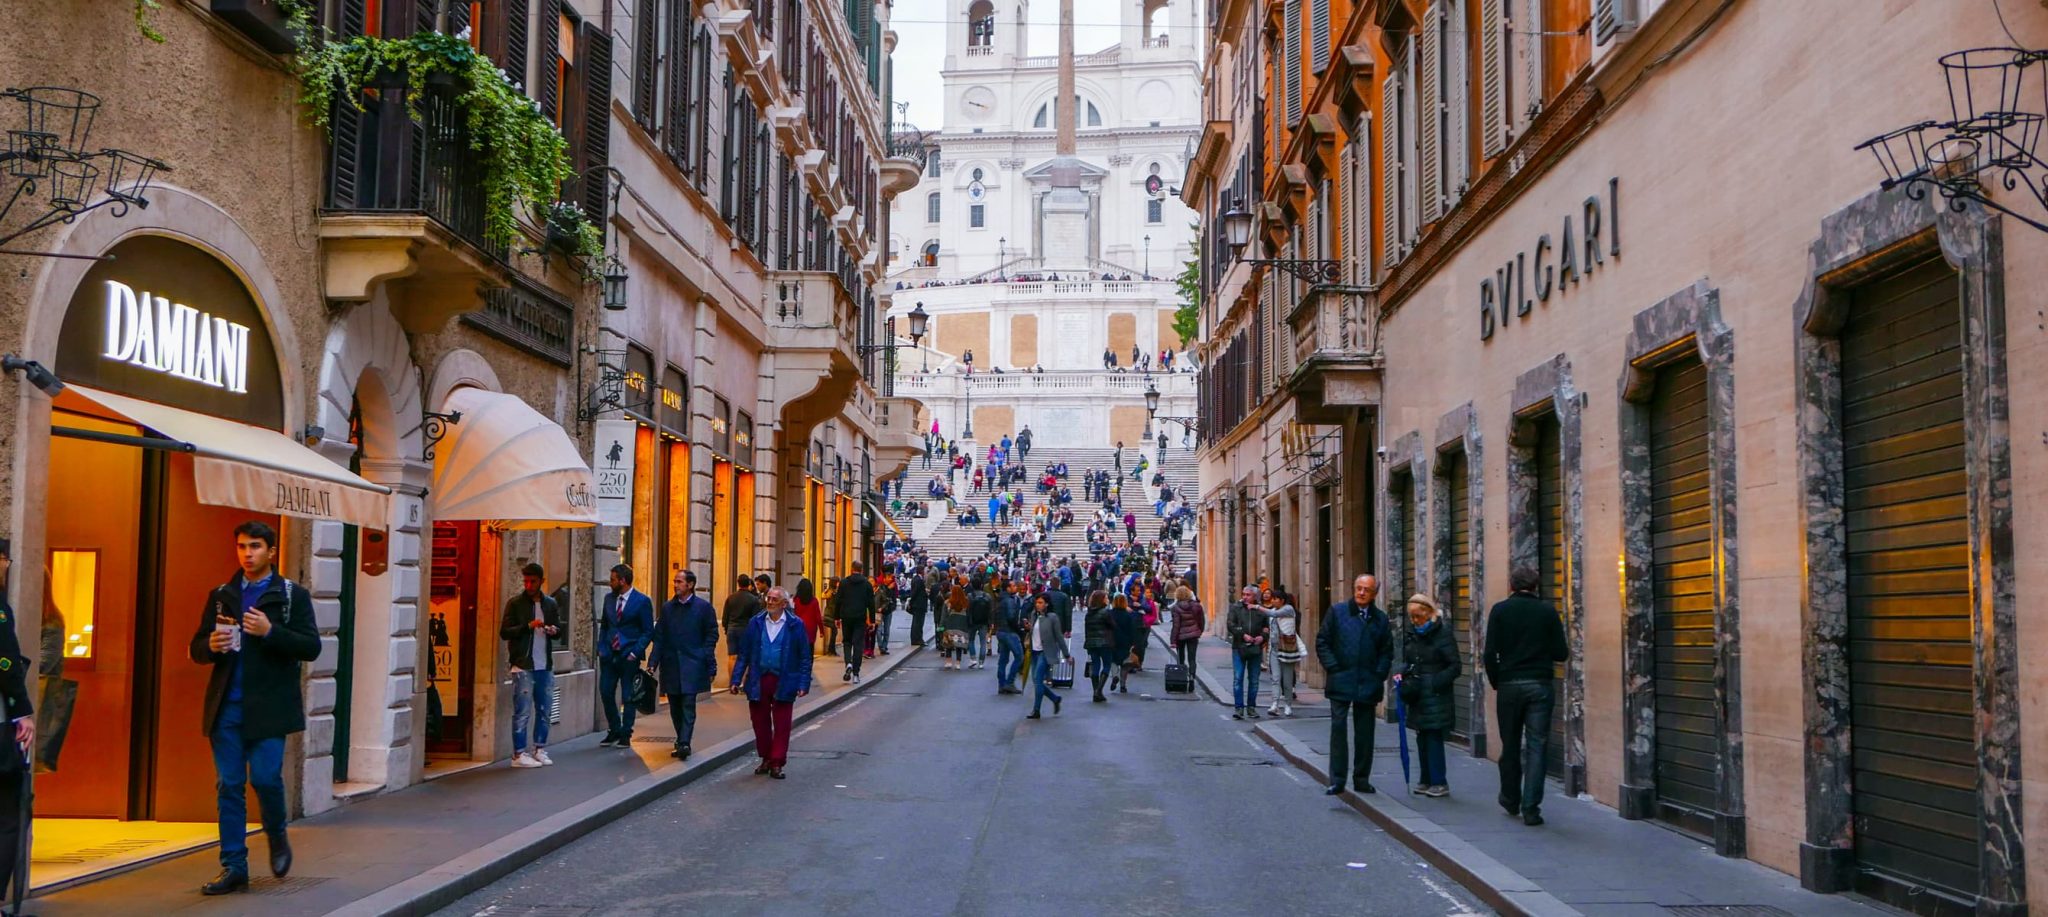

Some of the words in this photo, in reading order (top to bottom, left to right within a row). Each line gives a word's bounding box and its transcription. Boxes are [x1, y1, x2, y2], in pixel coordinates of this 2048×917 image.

[1479, 176, 1621, 341] BVLGARI
[102, 279, 250, 393] DAMIANI
[598, 487, 626, 495] ANNI
[599, 471, 627, 486] 250
[275, 482, 333, 517] DAMIANI
[434, 650, 452, 666] 50
